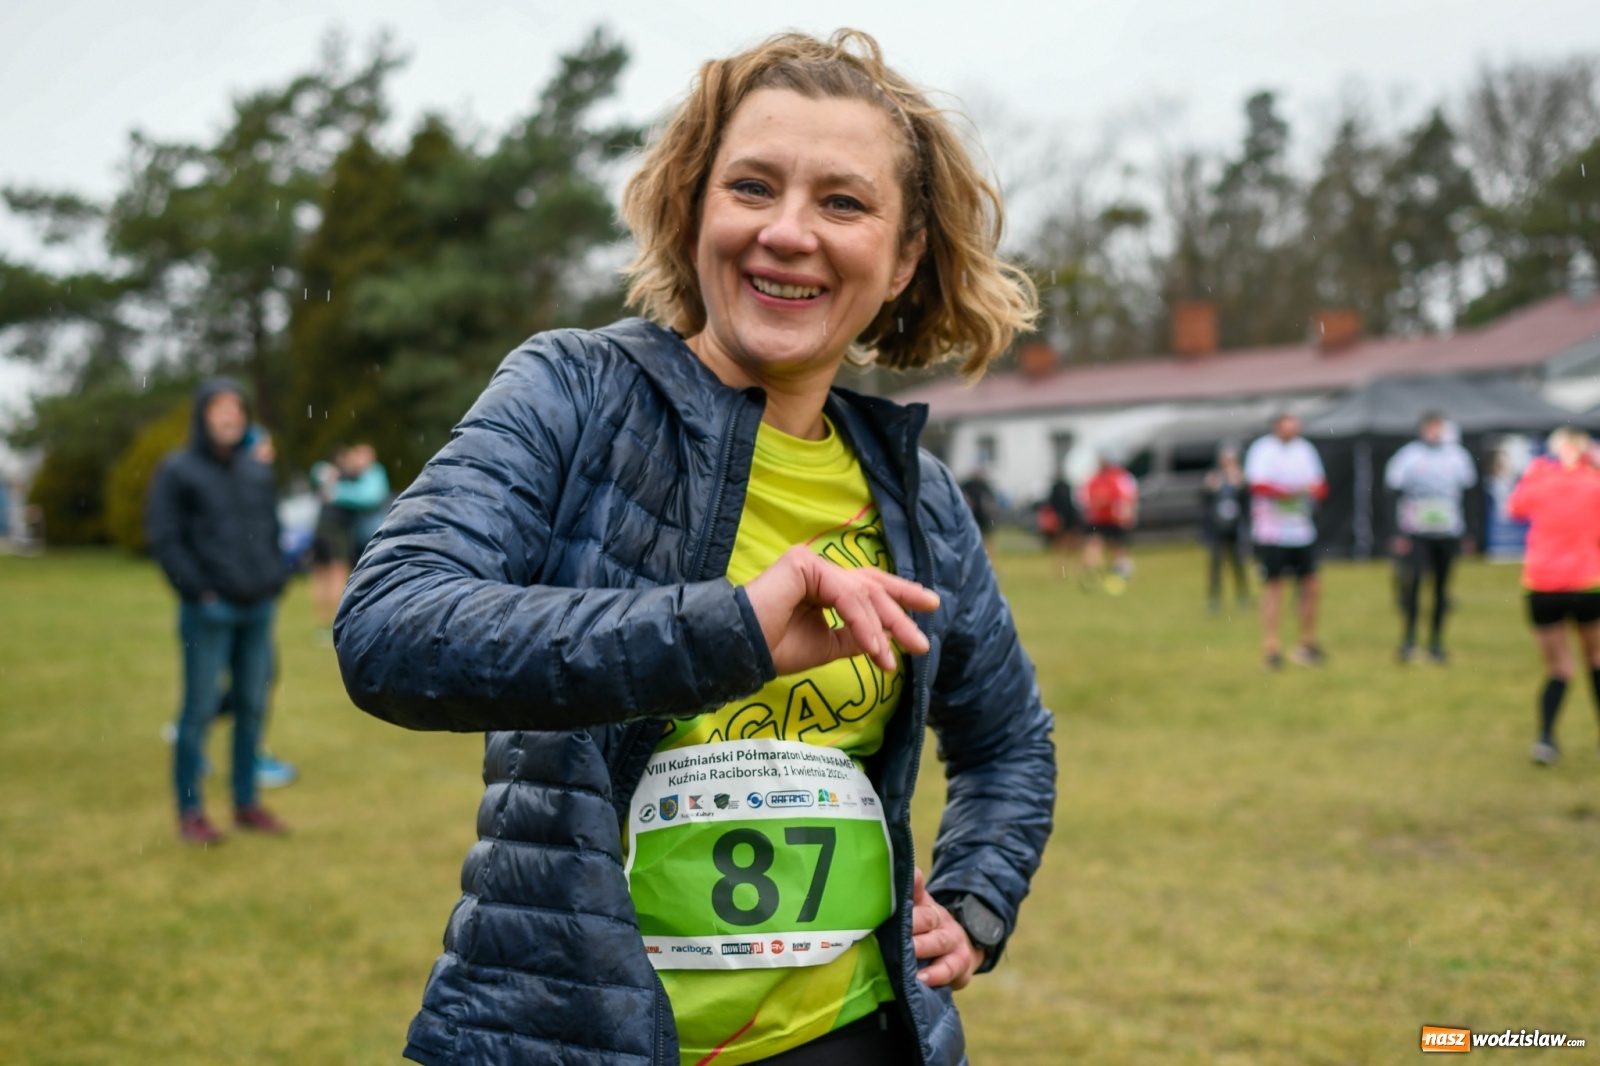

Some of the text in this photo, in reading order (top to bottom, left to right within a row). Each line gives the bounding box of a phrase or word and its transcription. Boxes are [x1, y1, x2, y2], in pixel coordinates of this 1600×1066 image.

[645, 762, 666, 776] VIII
[668, 751, 733, 771] Kuźniański
[736, 749, 800, 761] Półmaraton
[800, 751, 822, 764] Leśny
[668, 771, 707, 787] Kuźnia
[709, 766, 781, 780] Raciborska,
[784, 767, 790, 776] 1
[792, 766, 826, 778] kwietnia
[771, 795, 810, 804] RAFAMET
[712, 827, 837, 927] 87
[671, 944, 712, 953] raciborz
[722, 942, 763, 955] nowiny.pl
